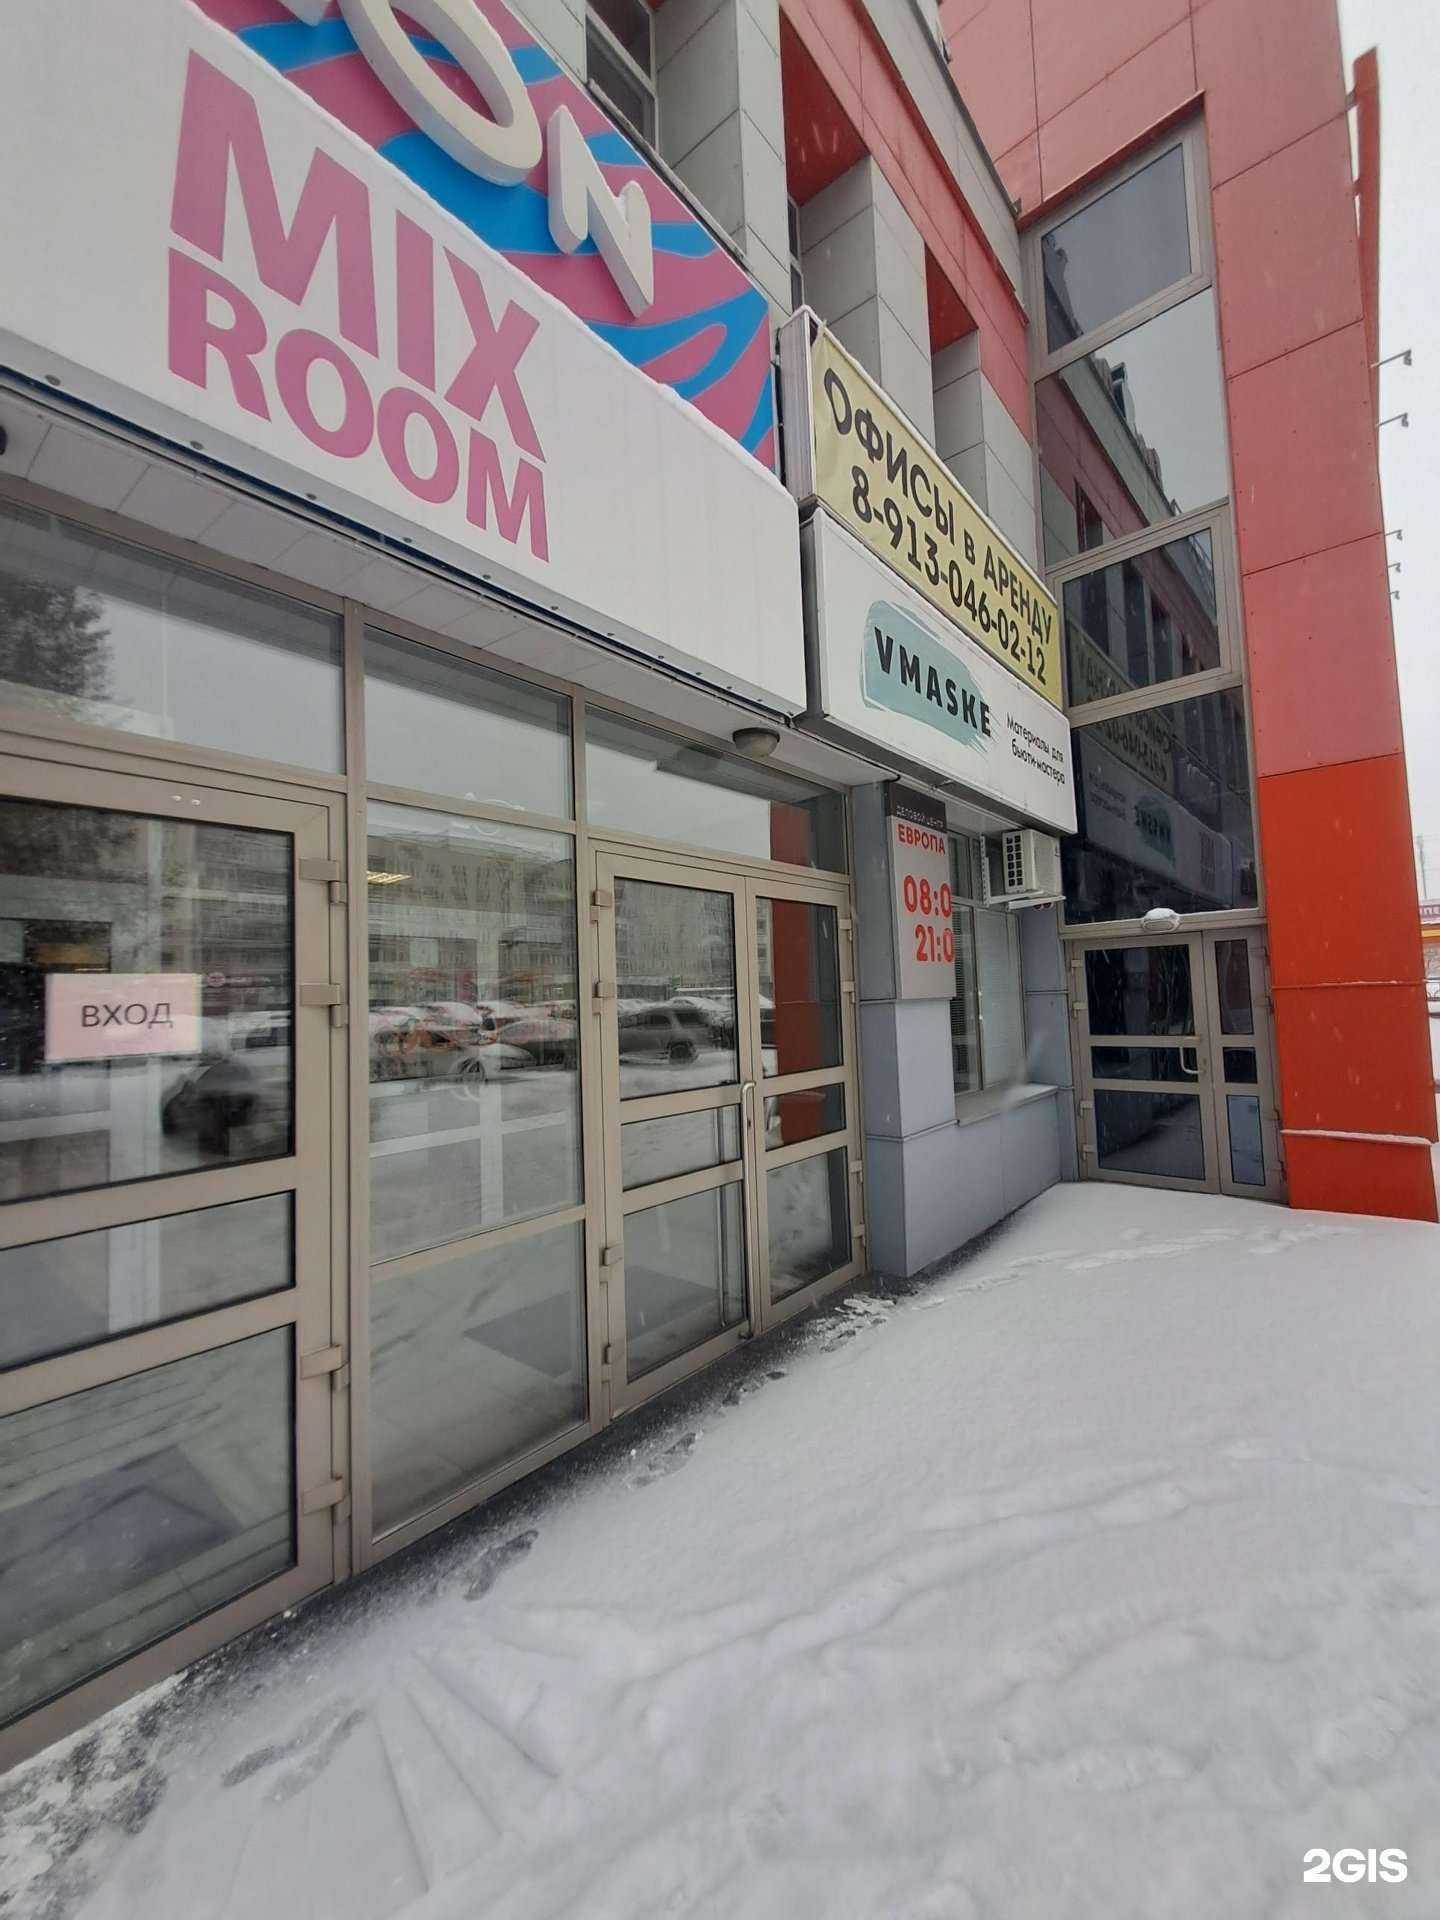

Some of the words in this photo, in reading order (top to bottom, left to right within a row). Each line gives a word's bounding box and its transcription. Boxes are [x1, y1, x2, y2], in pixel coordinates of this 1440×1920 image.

[170, 48, 546, 463] MIX
[276, 0, 653, 318] ON
[169, 247, 549, 563] ROOM
[823, 367, 955, 546] ОФИСЫ
[984, 544, 1053, 646] АРЕНДУ
[851, 465, 1047, 685] 8-913-046-02-12
[874, 627, 992, 738] VMASKE
[897, 824, 946, 855] ЕВРОПА
[1007, 712, 1049, 754] Материалы
[81, 1002, 174, 1029] ВХОД
